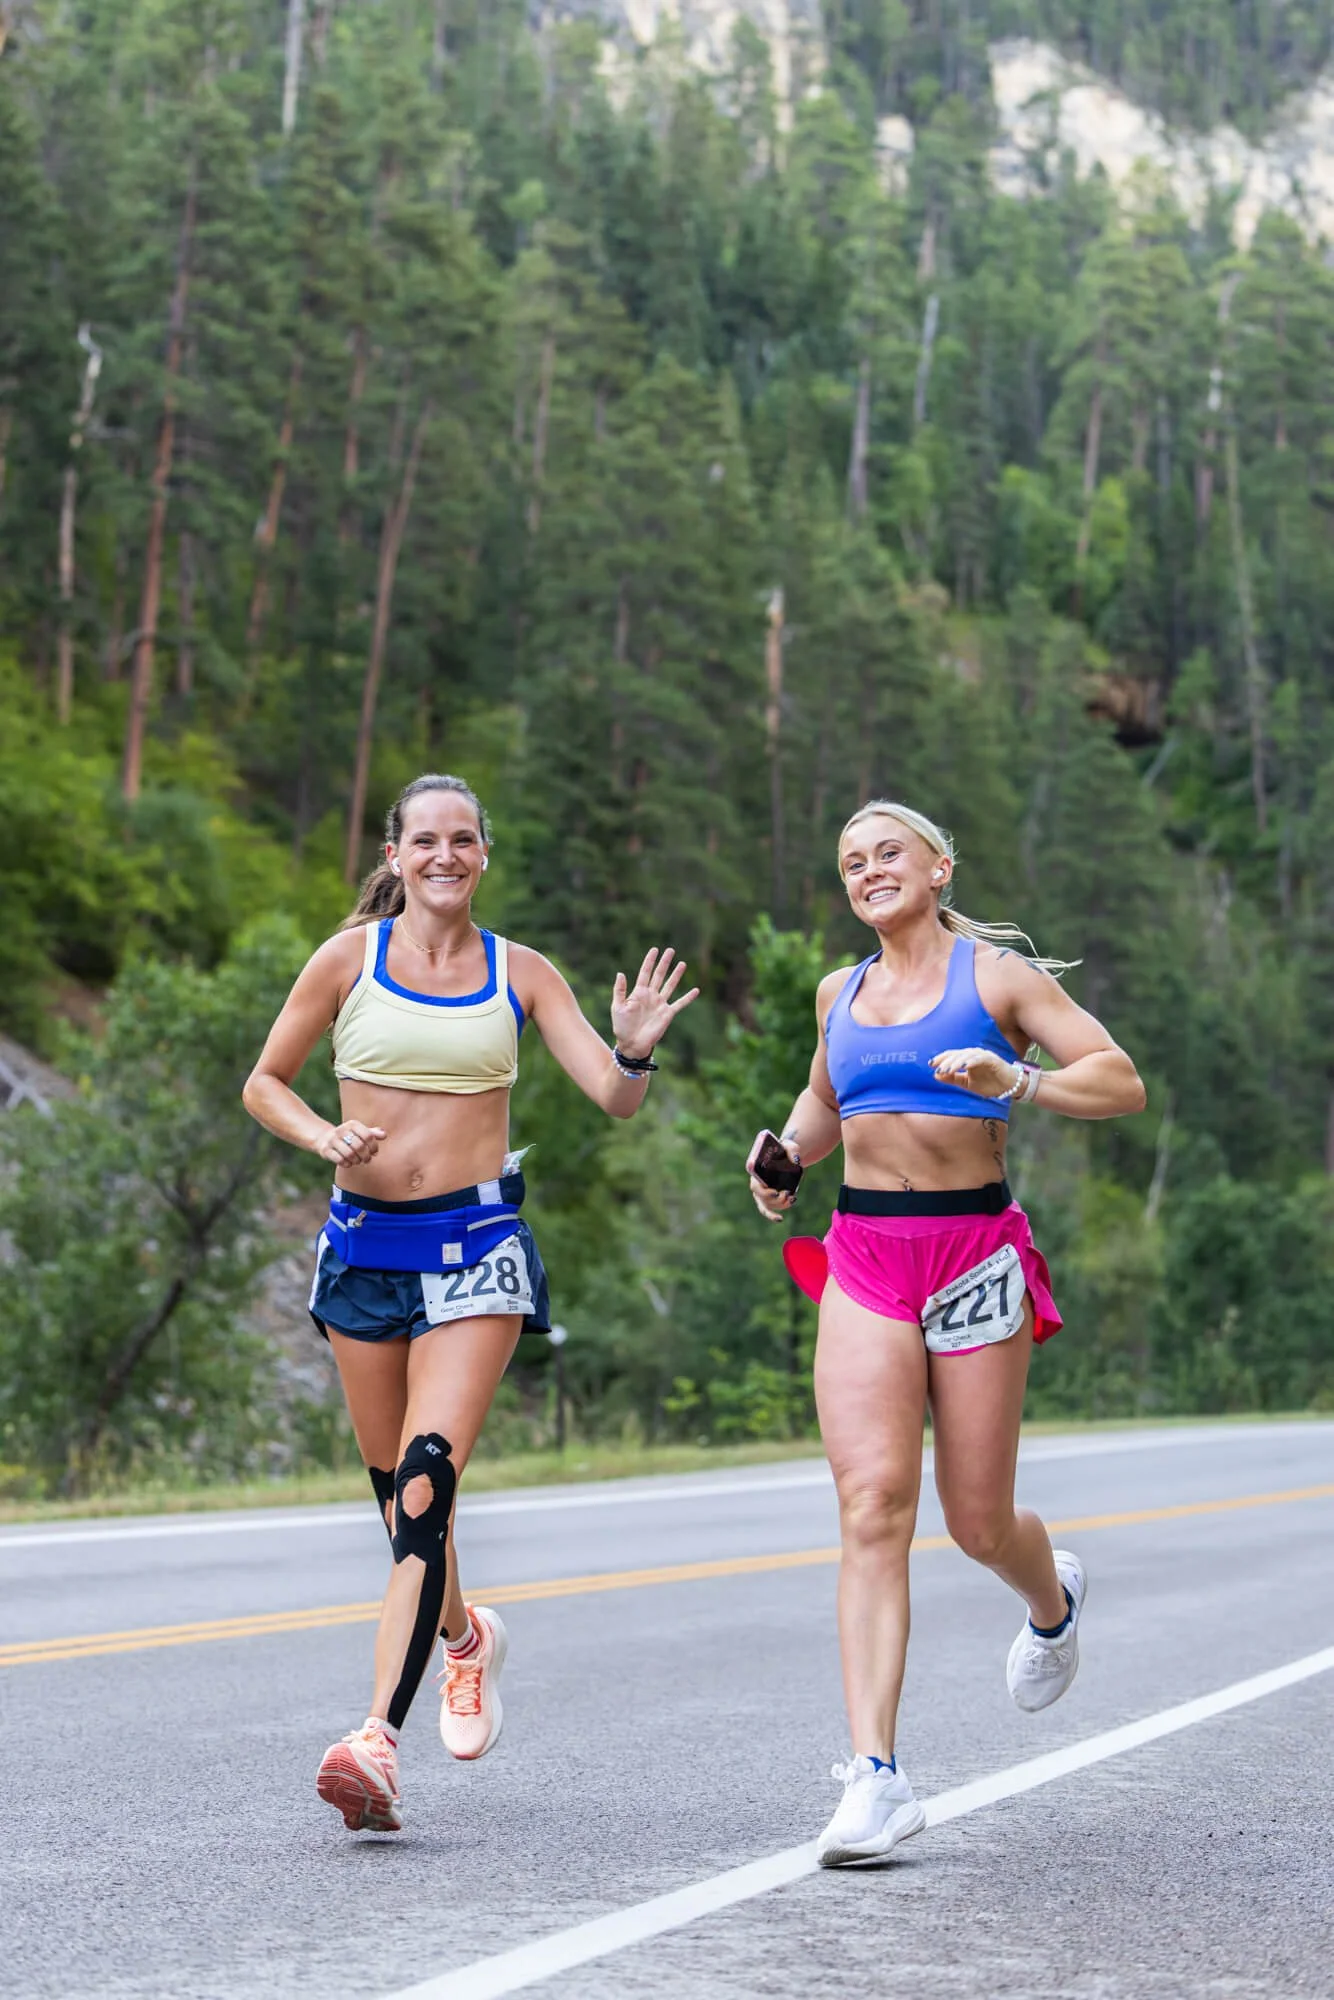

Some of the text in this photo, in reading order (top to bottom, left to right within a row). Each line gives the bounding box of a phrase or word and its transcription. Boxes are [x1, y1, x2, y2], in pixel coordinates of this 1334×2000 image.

[860, 1051, 918, 1066] VELITES
[440, 1256, 520, 1302] 228
[941, 1272, 1009, 1331] 227
[425, 1442, 442, 1456] KT
